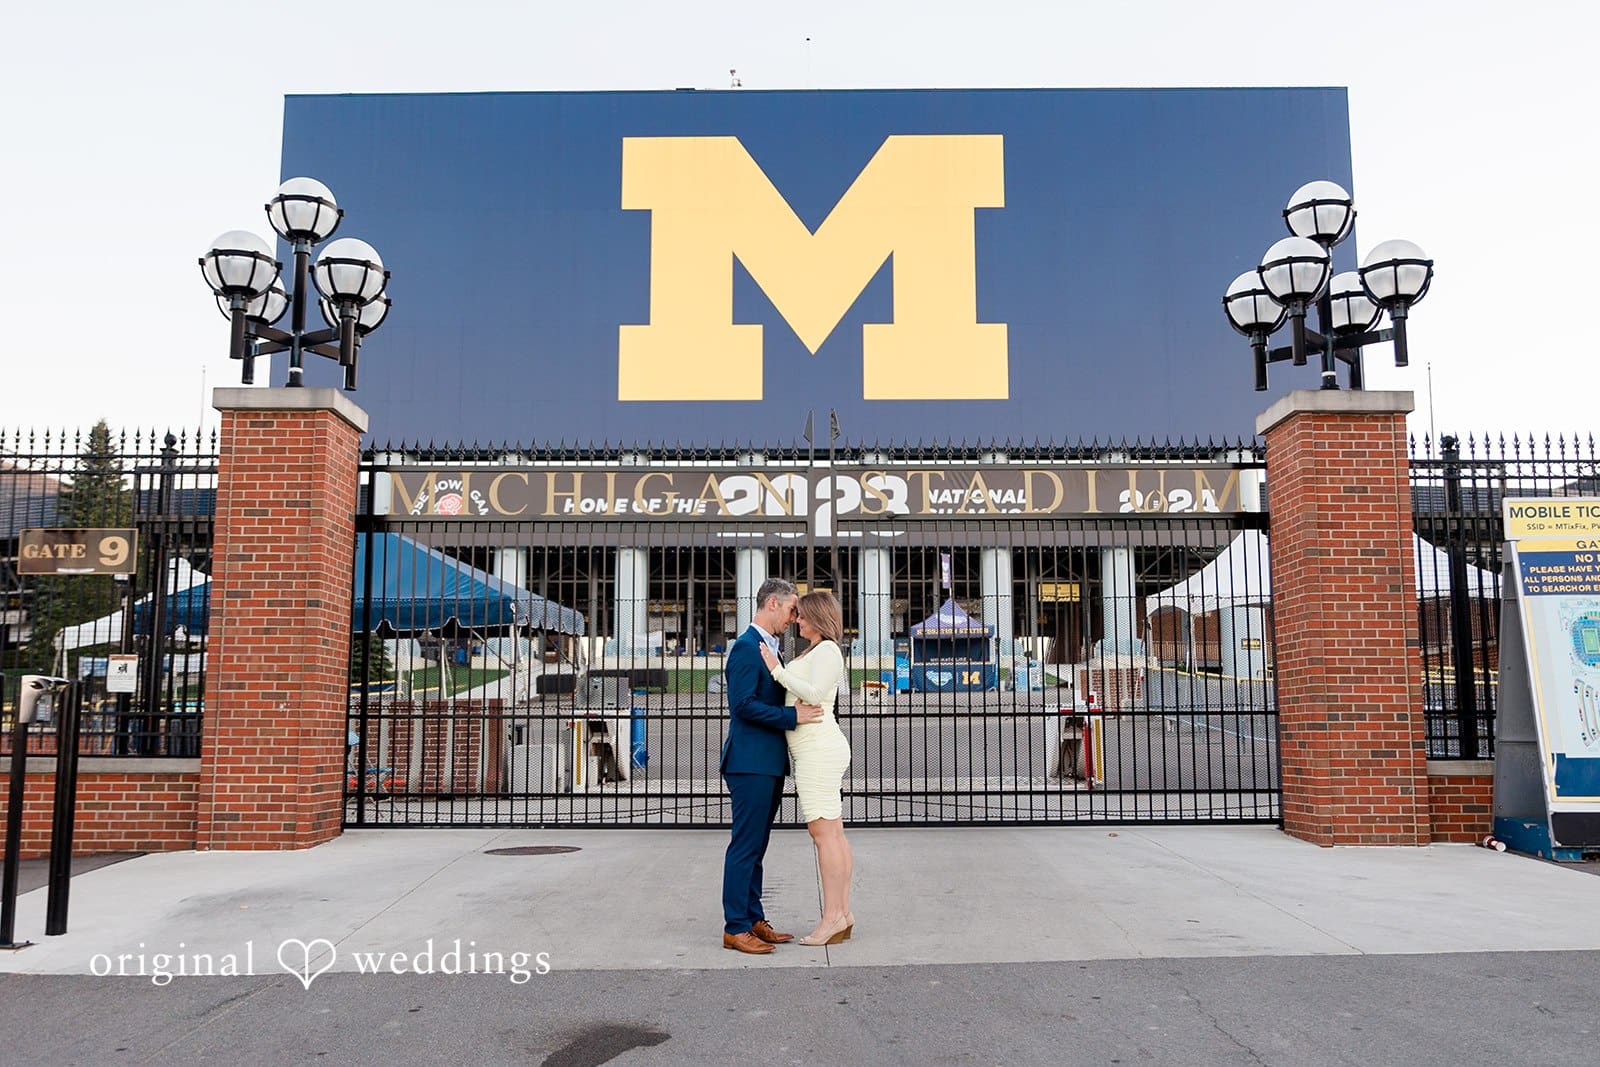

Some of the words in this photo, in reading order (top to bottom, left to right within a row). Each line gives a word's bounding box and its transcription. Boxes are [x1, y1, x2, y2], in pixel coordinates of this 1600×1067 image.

[617, 134, 1009, 400] M
[389, 471, 795, 516] MICHIGAN
[859, 470, 1241, 515] STADIUM
[564, 498, 628, 513] HOME
[1509, 506, 1571, 518] MOBILE
[23, 543, 87, 559] GATE
[98, 536, 129, 566] 9
[1575, 554, 1594, 563] NO
[1568, 565, 1593, 573] HAVE
